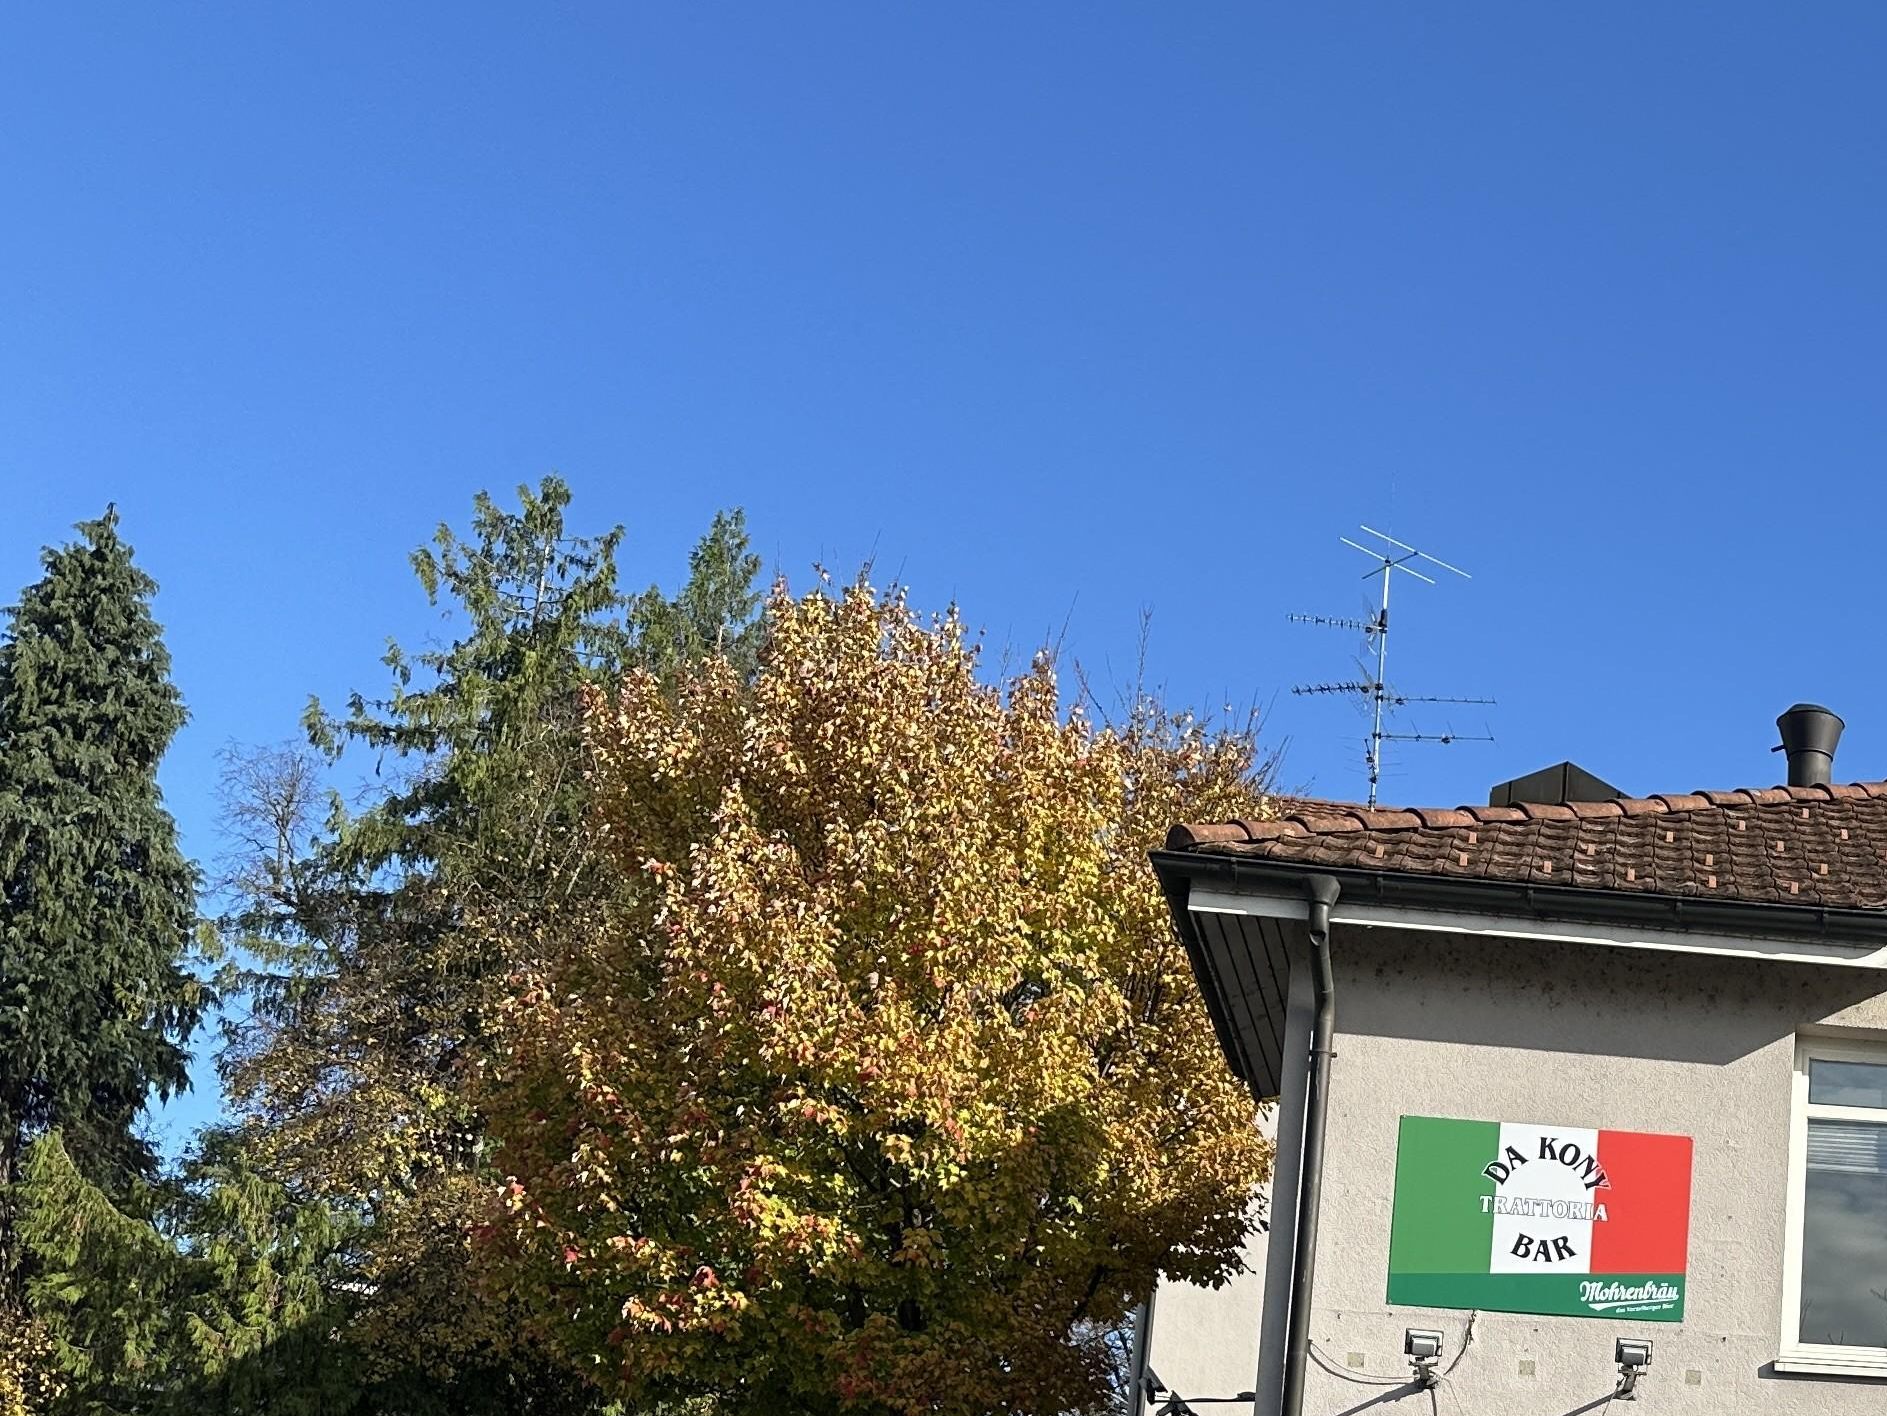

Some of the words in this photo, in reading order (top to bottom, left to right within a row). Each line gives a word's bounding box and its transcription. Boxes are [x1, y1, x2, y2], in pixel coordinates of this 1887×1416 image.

[1482, 1144, 1529, 1186] DA
[1537, 1135, 1611, 1191] KONY
[1479, 1194, 1608, 1222] TRATTORIA
[1509, 1232, 1578, 1263] BAR
[1580, 1280, 1680, 1302] Mohrenbräu
